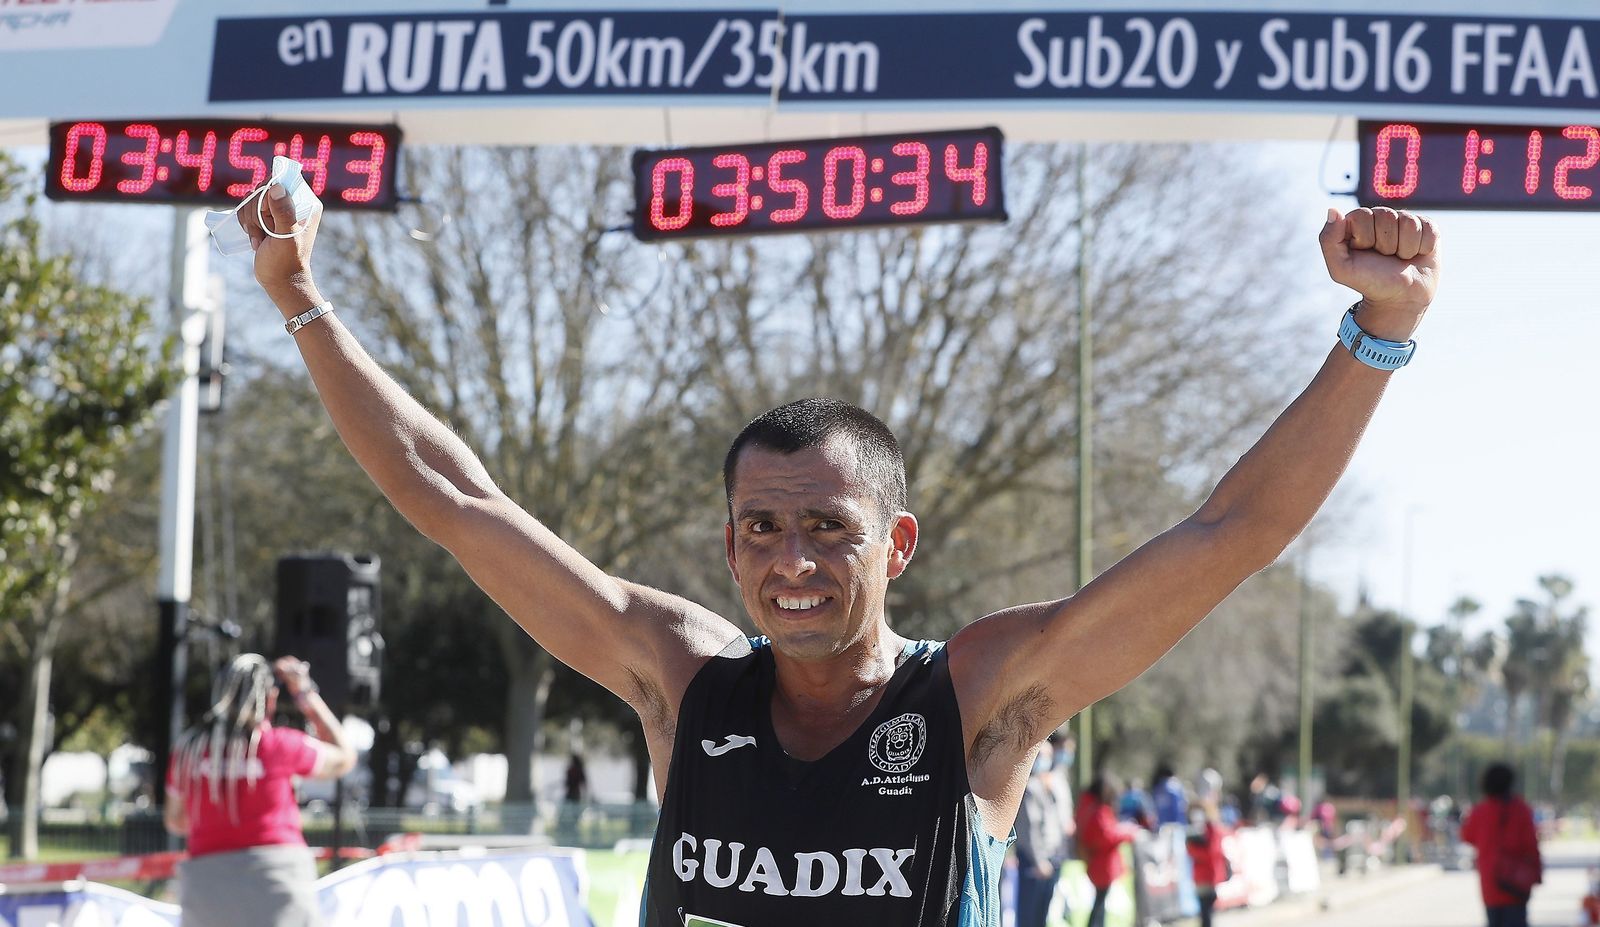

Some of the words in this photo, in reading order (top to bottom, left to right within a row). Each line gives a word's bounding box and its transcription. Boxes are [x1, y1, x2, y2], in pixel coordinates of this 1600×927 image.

[277, 19, 333, 67] en
[342, 20, 507, 95] RUTA
[523, 19, 880, 94] 50km/35km
[1014, 16, 1199, 90] Sub20
[1214, 39, 1242, 90] y
[1258, 17, 1431, 94] Sub16
[1451, 22, 1600, 98] FFAA
[61, 122, 385, 203] 03:45:43
[650, 141, 988, 231] 03:50:34
[878, 785, 913, 796] Guadix
[672, 831, 915, 898] GUADIX
